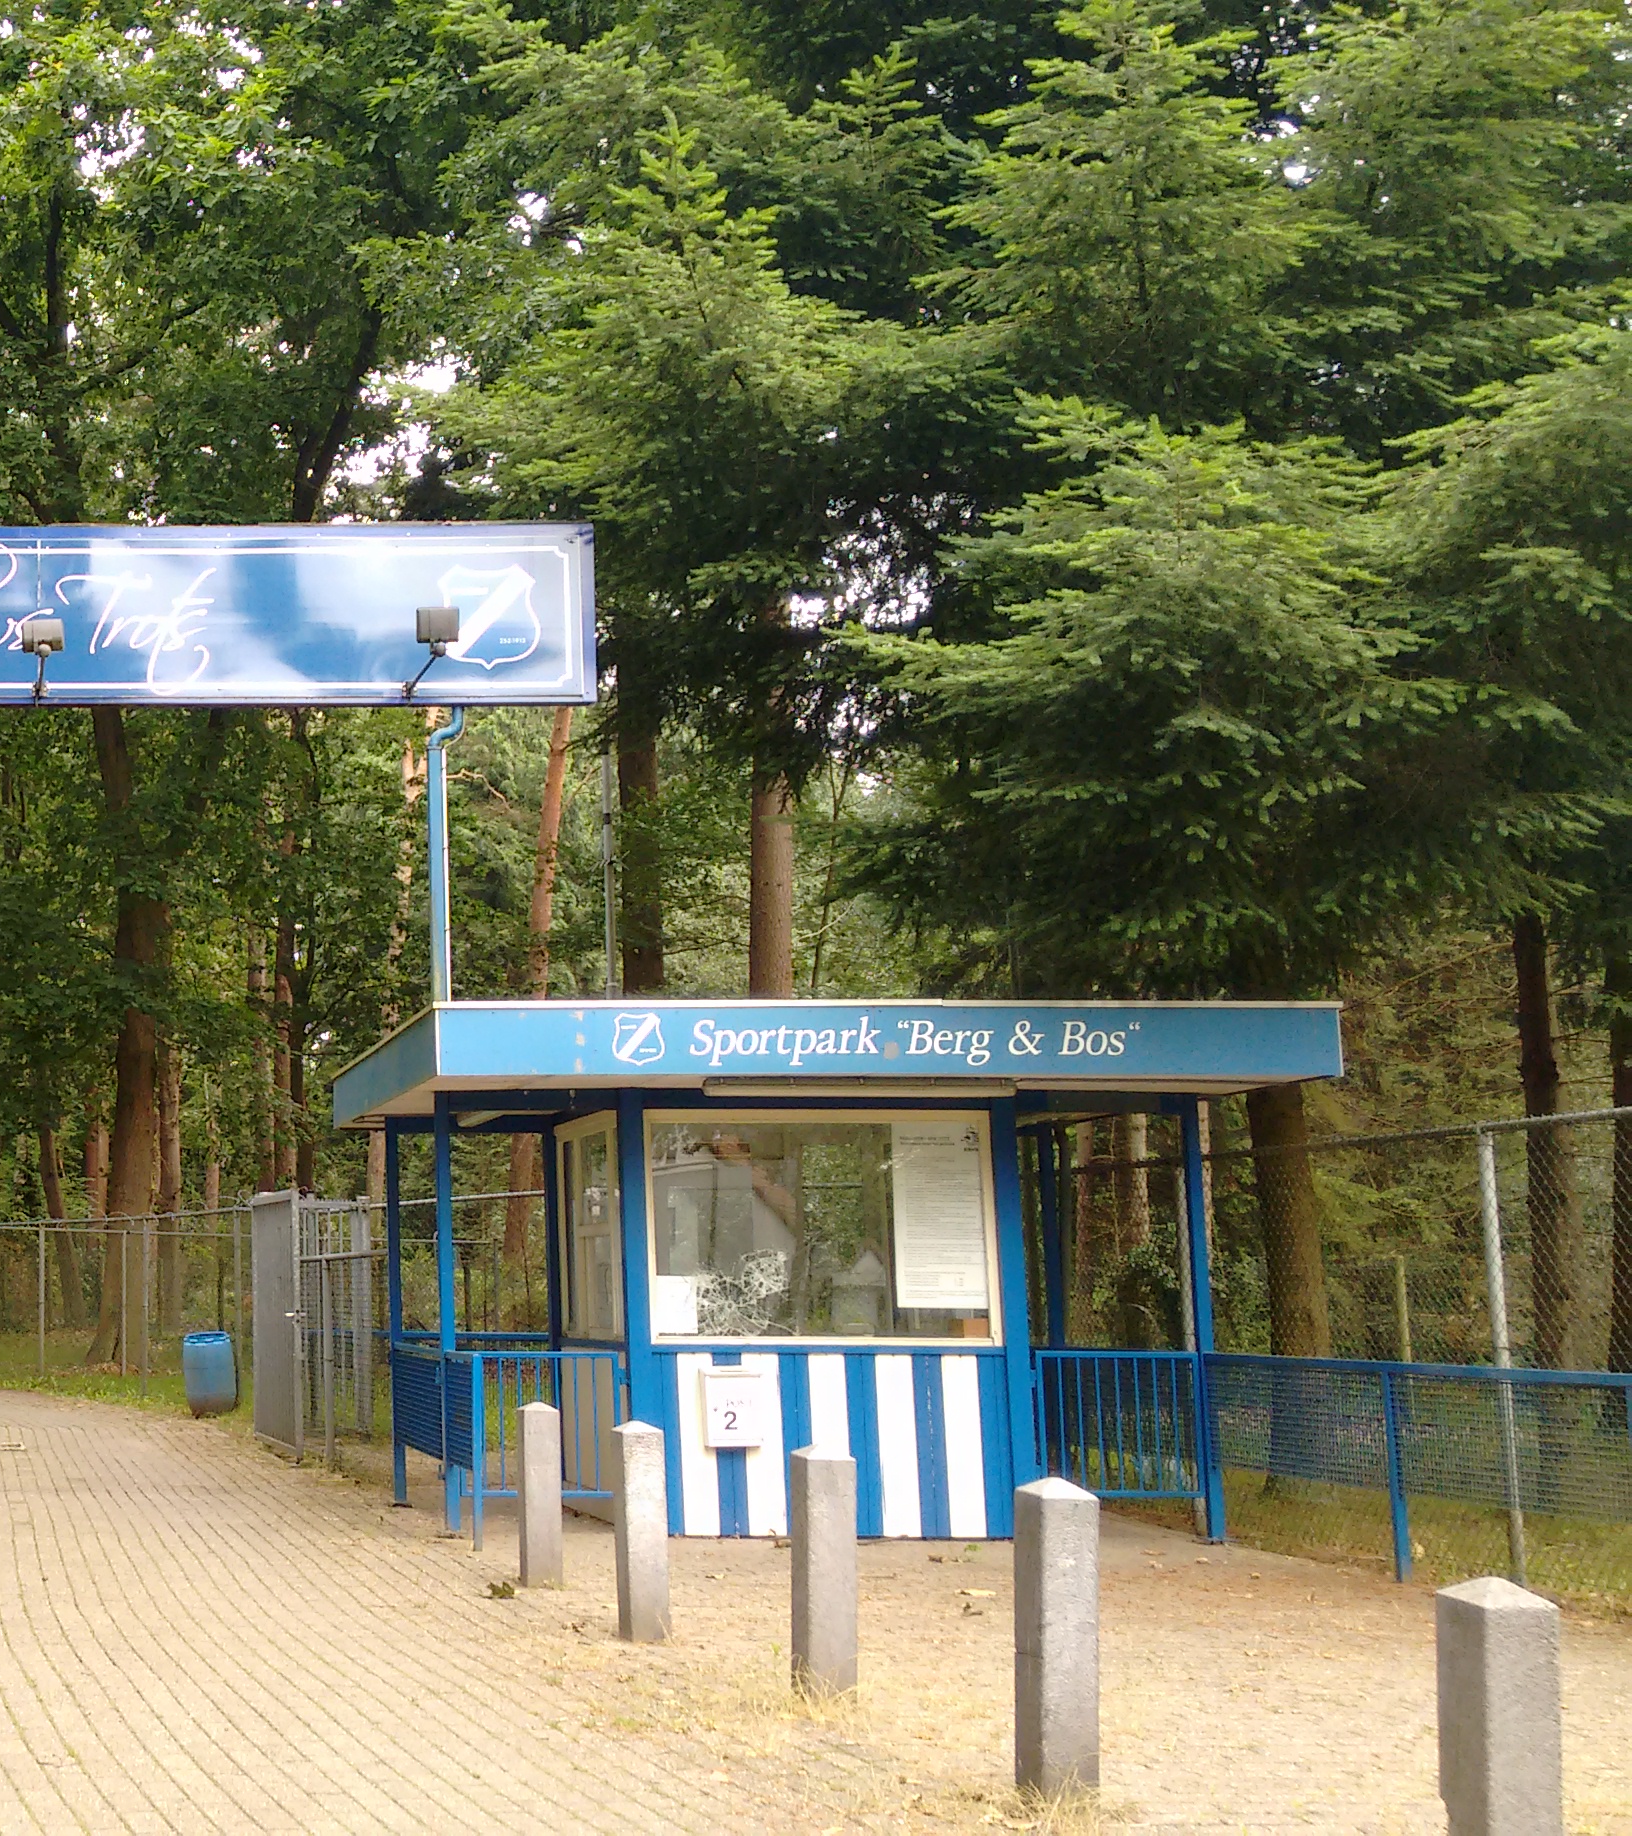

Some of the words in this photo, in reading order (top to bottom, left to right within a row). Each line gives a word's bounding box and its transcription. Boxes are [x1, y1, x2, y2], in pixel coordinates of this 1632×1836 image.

[55, 567, 217, 696] Trots
[689, 1015, 882, 1067] Sportpark
[1008, 1020, 1046, 1056] &
[724, 1410, 739, 1431] 2
